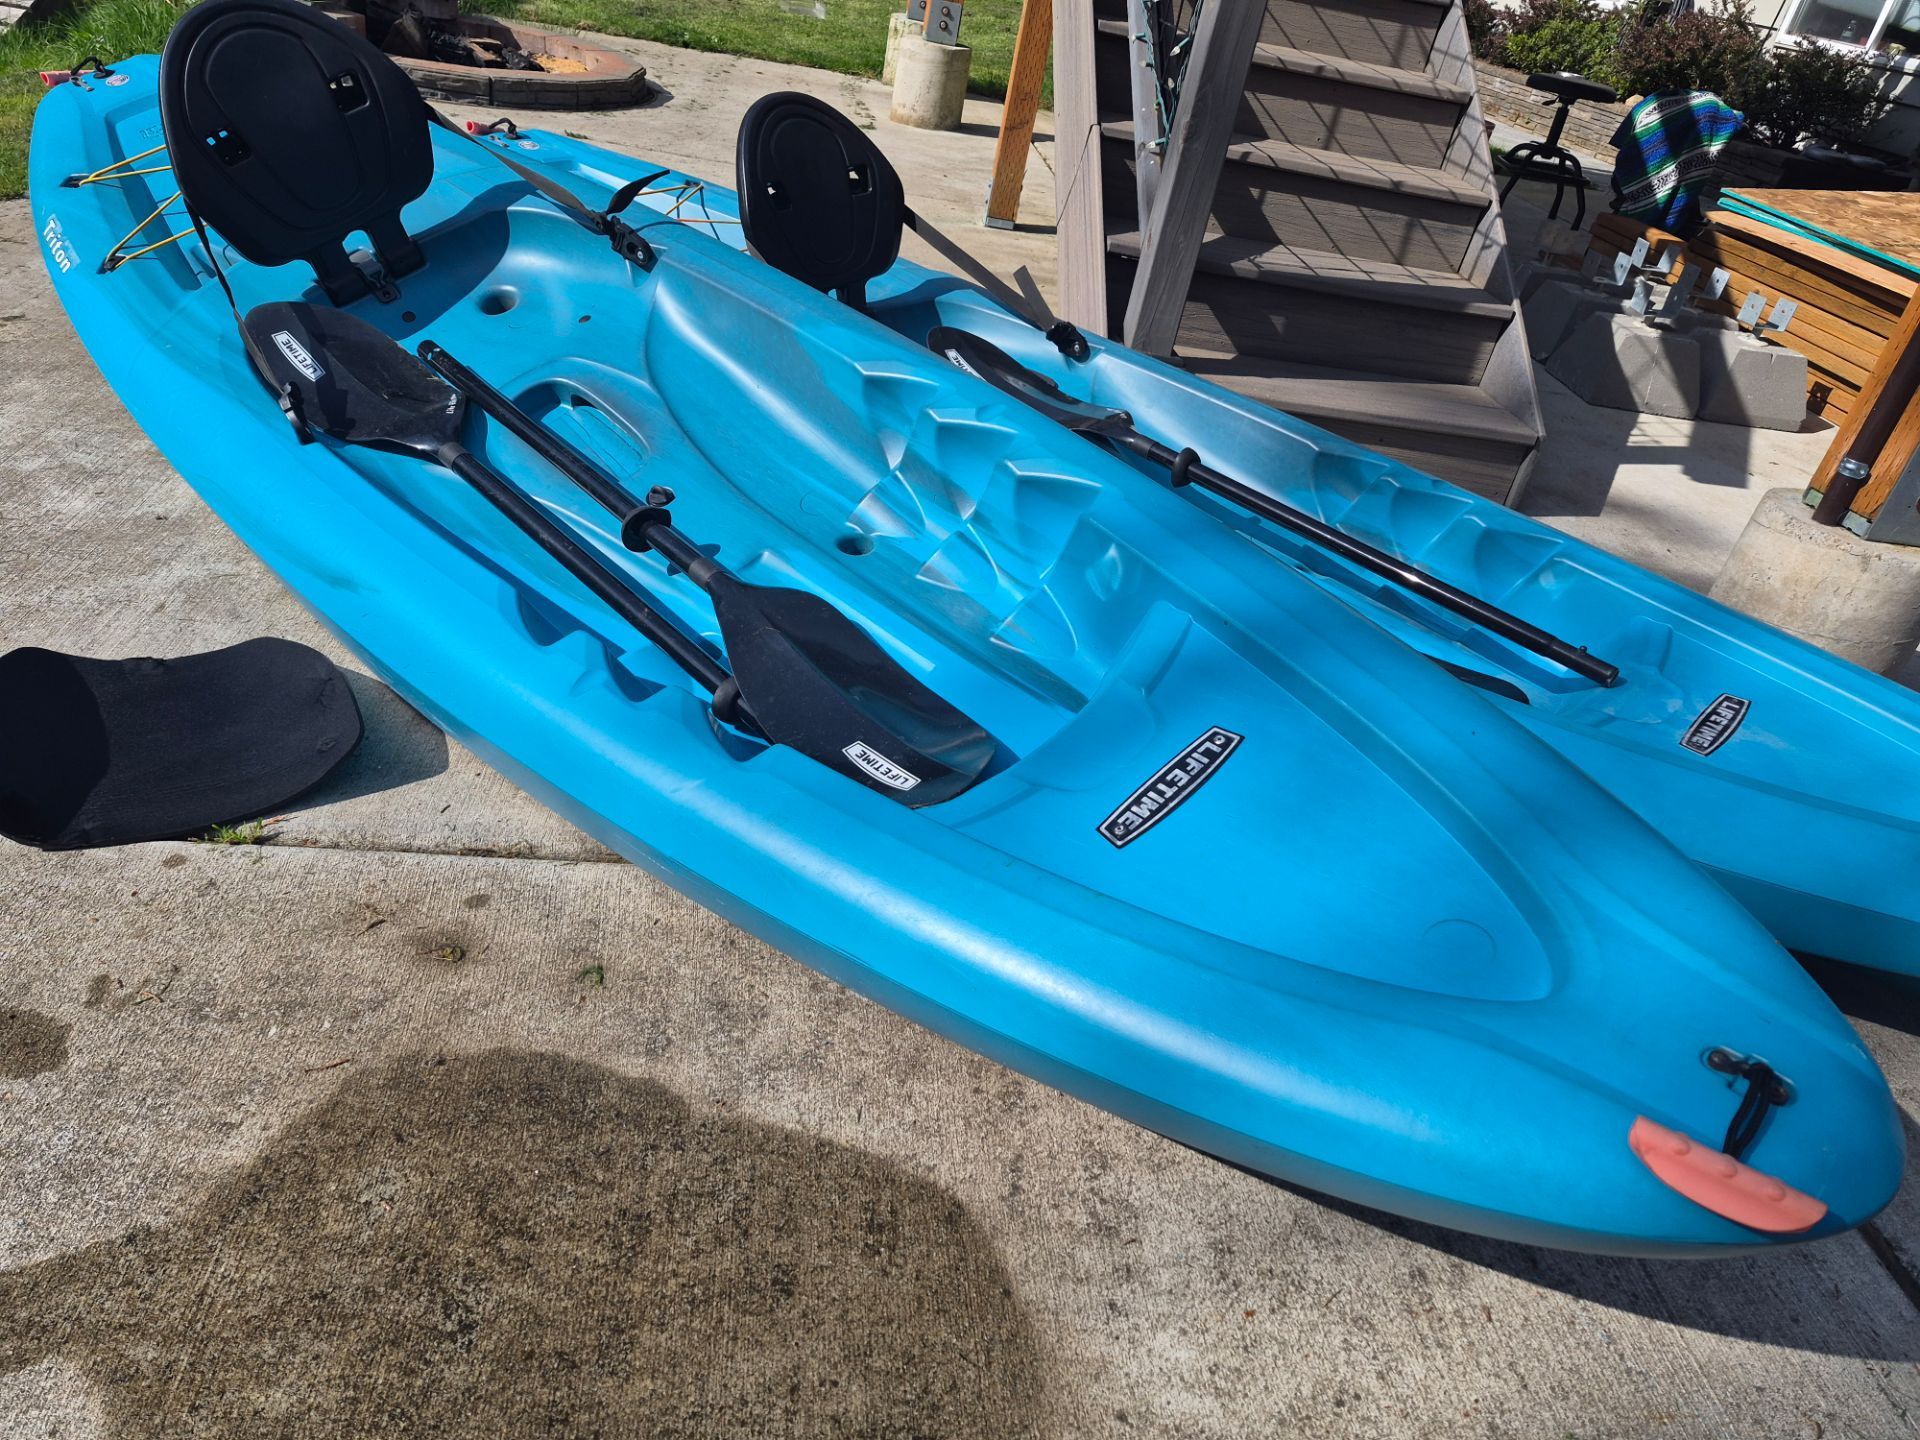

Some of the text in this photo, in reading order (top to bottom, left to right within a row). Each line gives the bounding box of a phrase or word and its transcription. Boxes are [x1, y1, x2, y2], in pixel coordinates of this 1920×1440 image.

[43, 219, 71, 273] Triton
[281, 338, 318, 375] LIFETIME
[1690, 701, 1740, 748] LIFETIME
[855, 749, 909, 785] LIFETIME
[1117, 740, 1223, 831] LIFETIME
